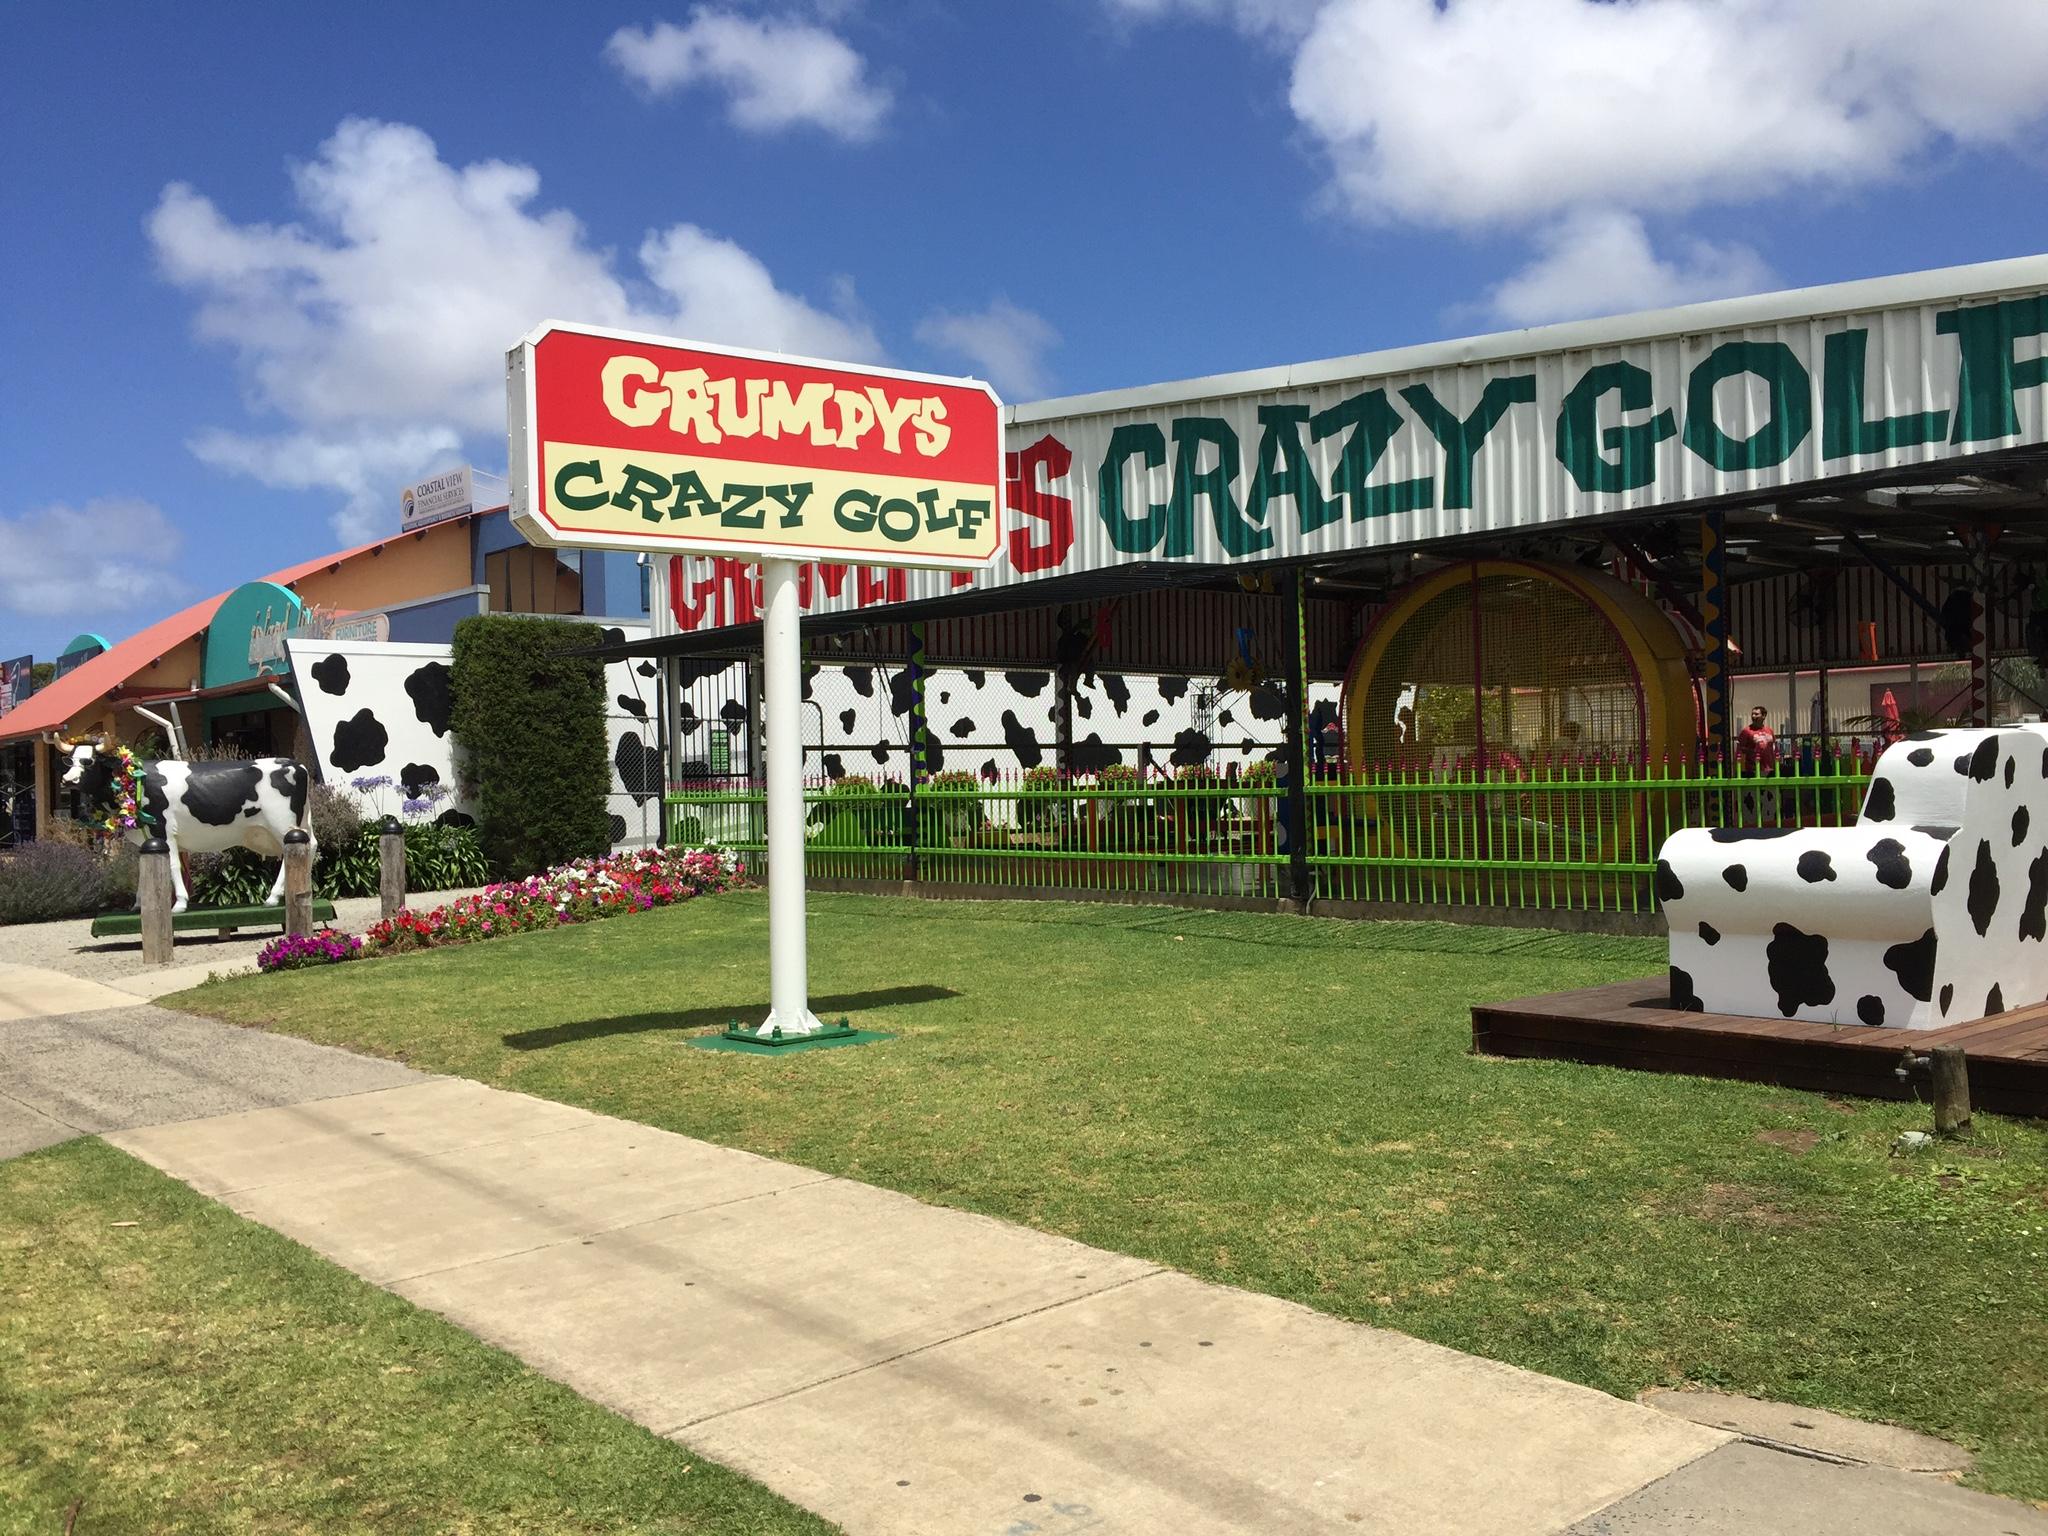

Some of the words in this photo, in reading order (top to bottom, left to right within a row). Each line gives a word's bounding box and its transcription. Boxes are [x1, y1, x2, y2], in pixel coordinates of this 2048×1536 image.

[601, 355, 952, 458] GRUMPYS
[1098, 374, 1536, 558] CRAZY
[1556, 295, 2048, 494] GOLF
[416, 479, 446, 498] COASTAL
[445, 472, 463, 487] VIEW
[417, 493, 443, 507] FINANCIAL
[442, 487, 465, 499] SERVICES
[553, 459, 814, 530] CRAZY
[833, 487, 991, 542] GOLF
[335, 620, 378, 640] FURNITURE
